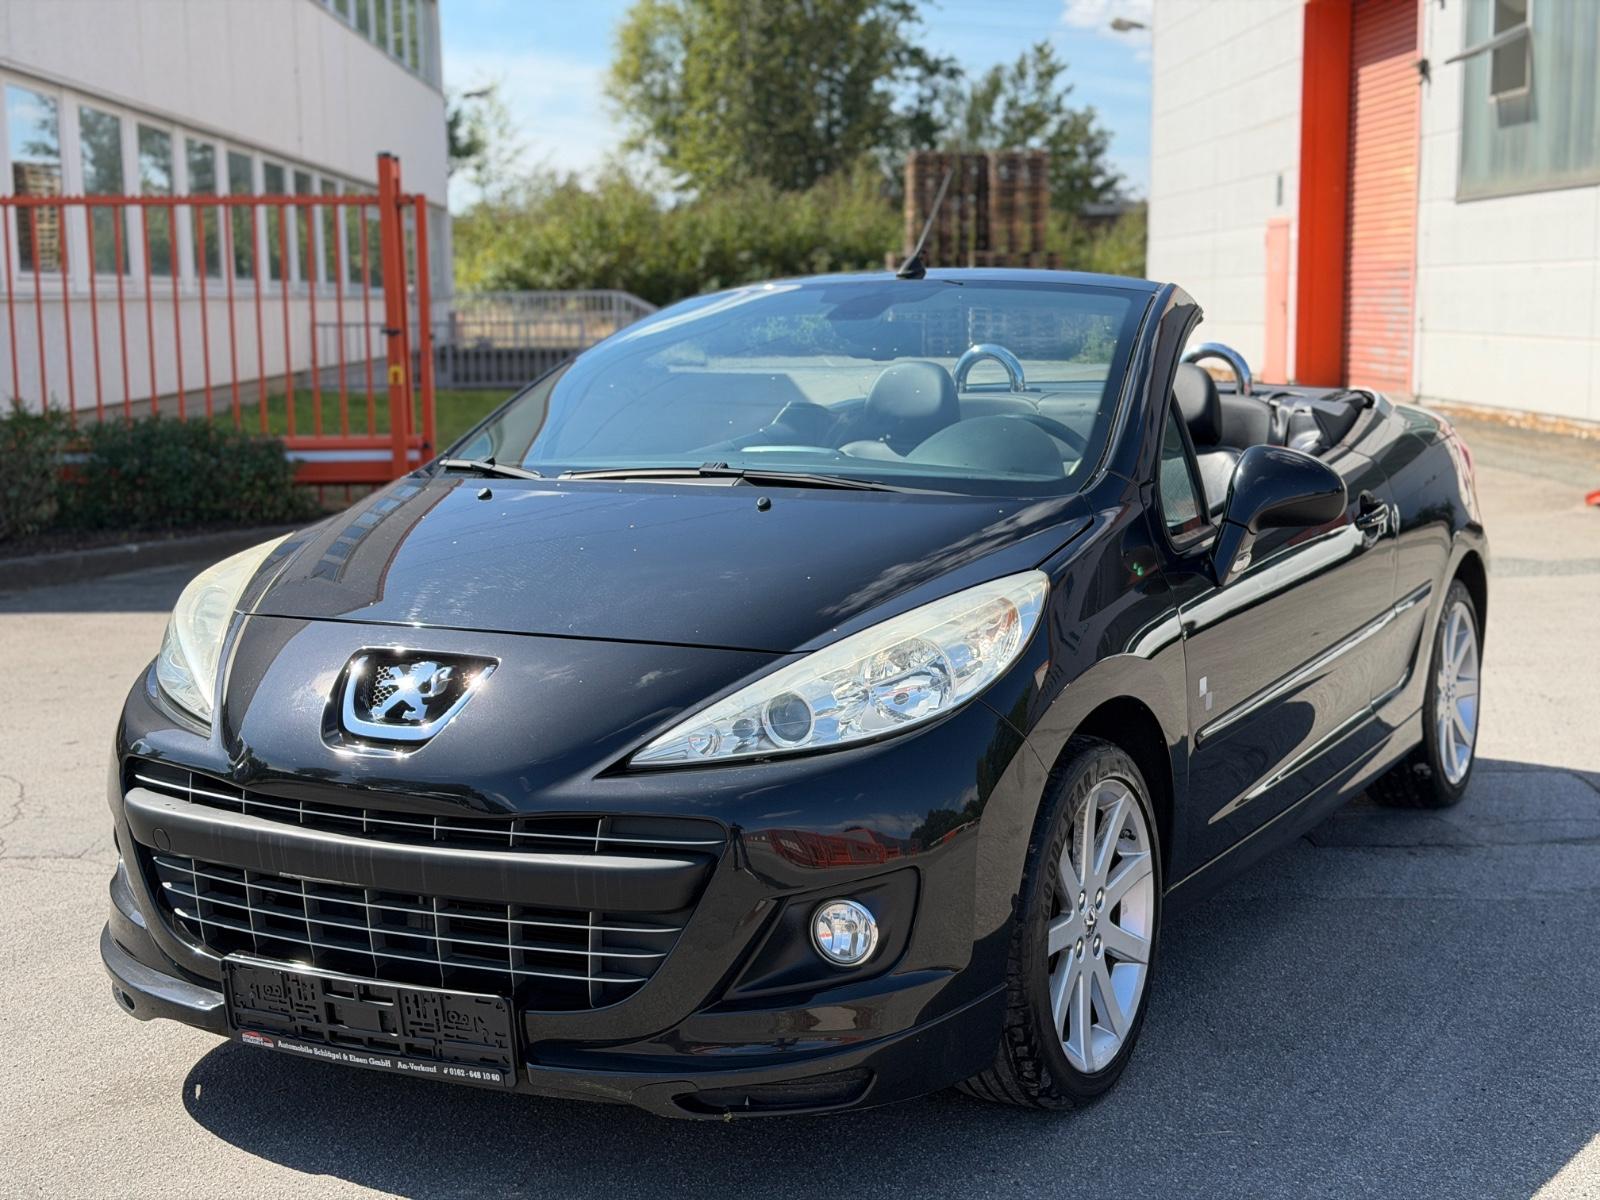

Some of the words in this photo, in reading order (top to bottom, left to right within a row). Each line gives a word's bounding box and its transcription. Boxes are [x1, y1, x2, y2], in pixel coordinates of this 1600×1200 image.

[278, 1040, 313, 1054] Automobile
[368, 1057, 391, 1068] GmbH
[397, 1061, 437, 1073] An-Verkauf
